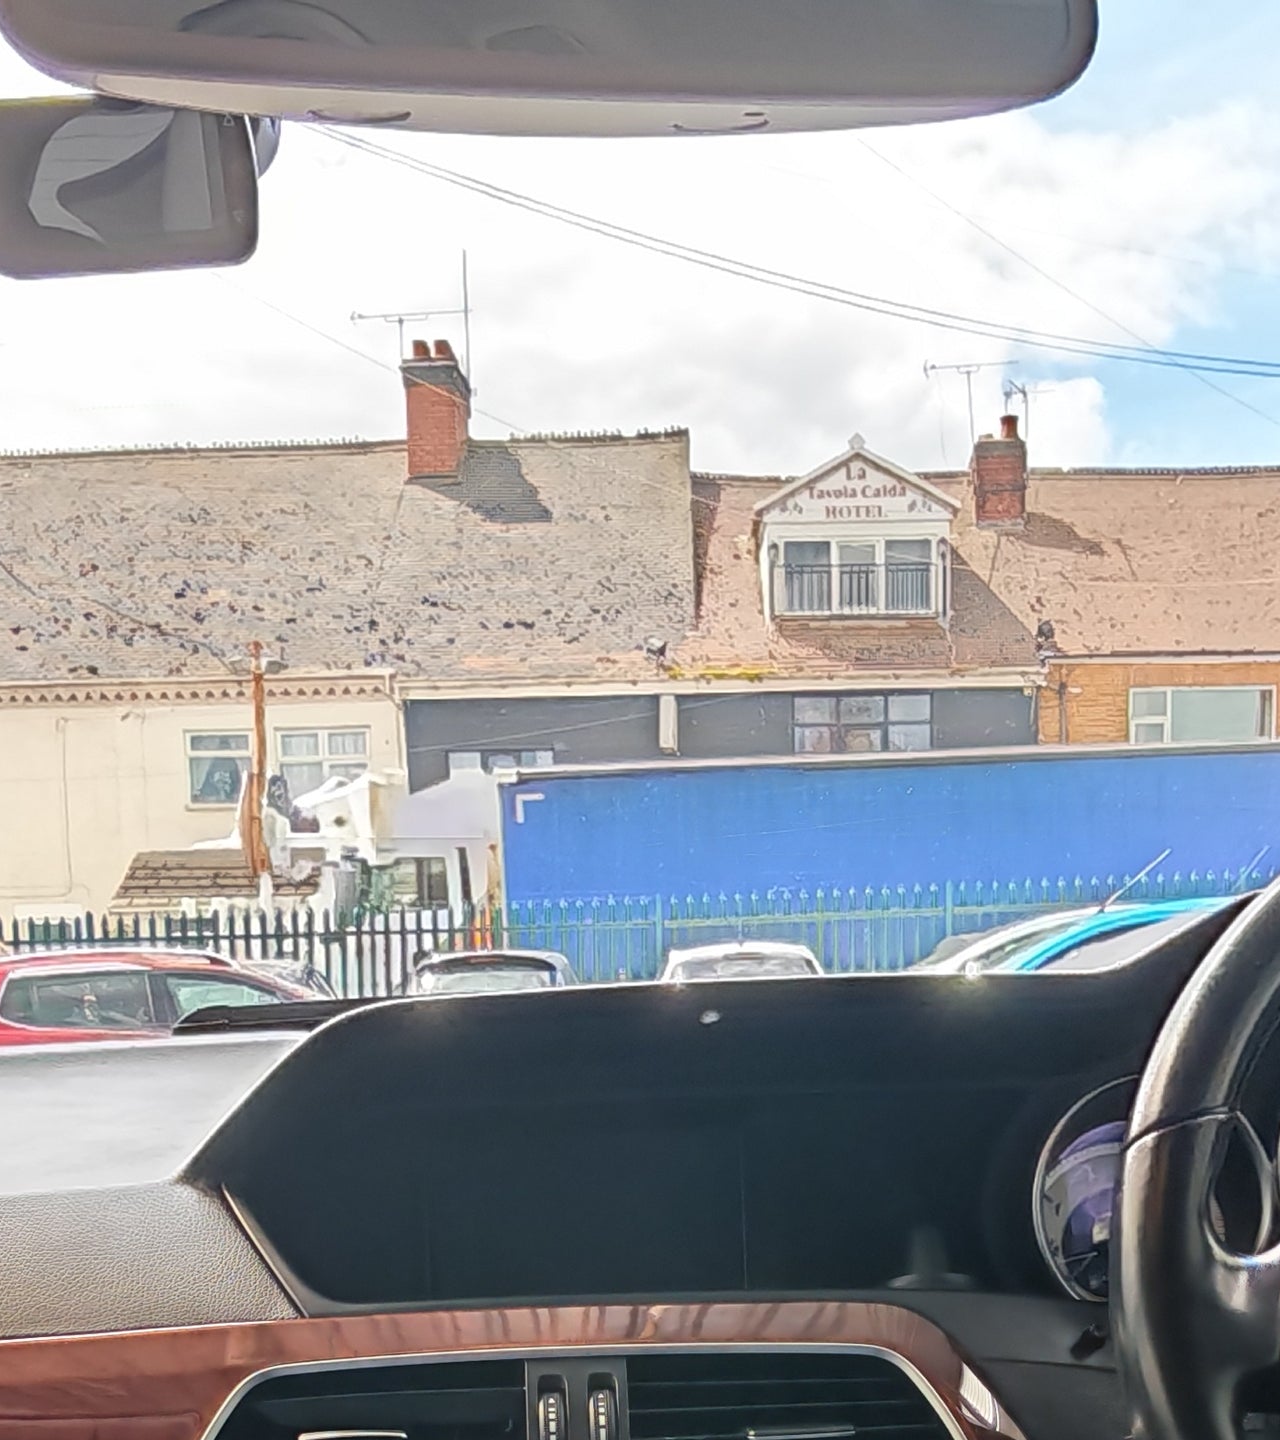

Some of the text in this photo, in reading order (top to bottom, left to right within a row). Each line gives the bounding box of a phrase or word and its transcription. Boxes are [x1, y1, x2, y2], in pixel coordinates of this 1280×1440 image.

[845, 462, 867, 481] La
[808, 484, 858, 500] Tavola
[824, 505, 888, 519] HOTEL
